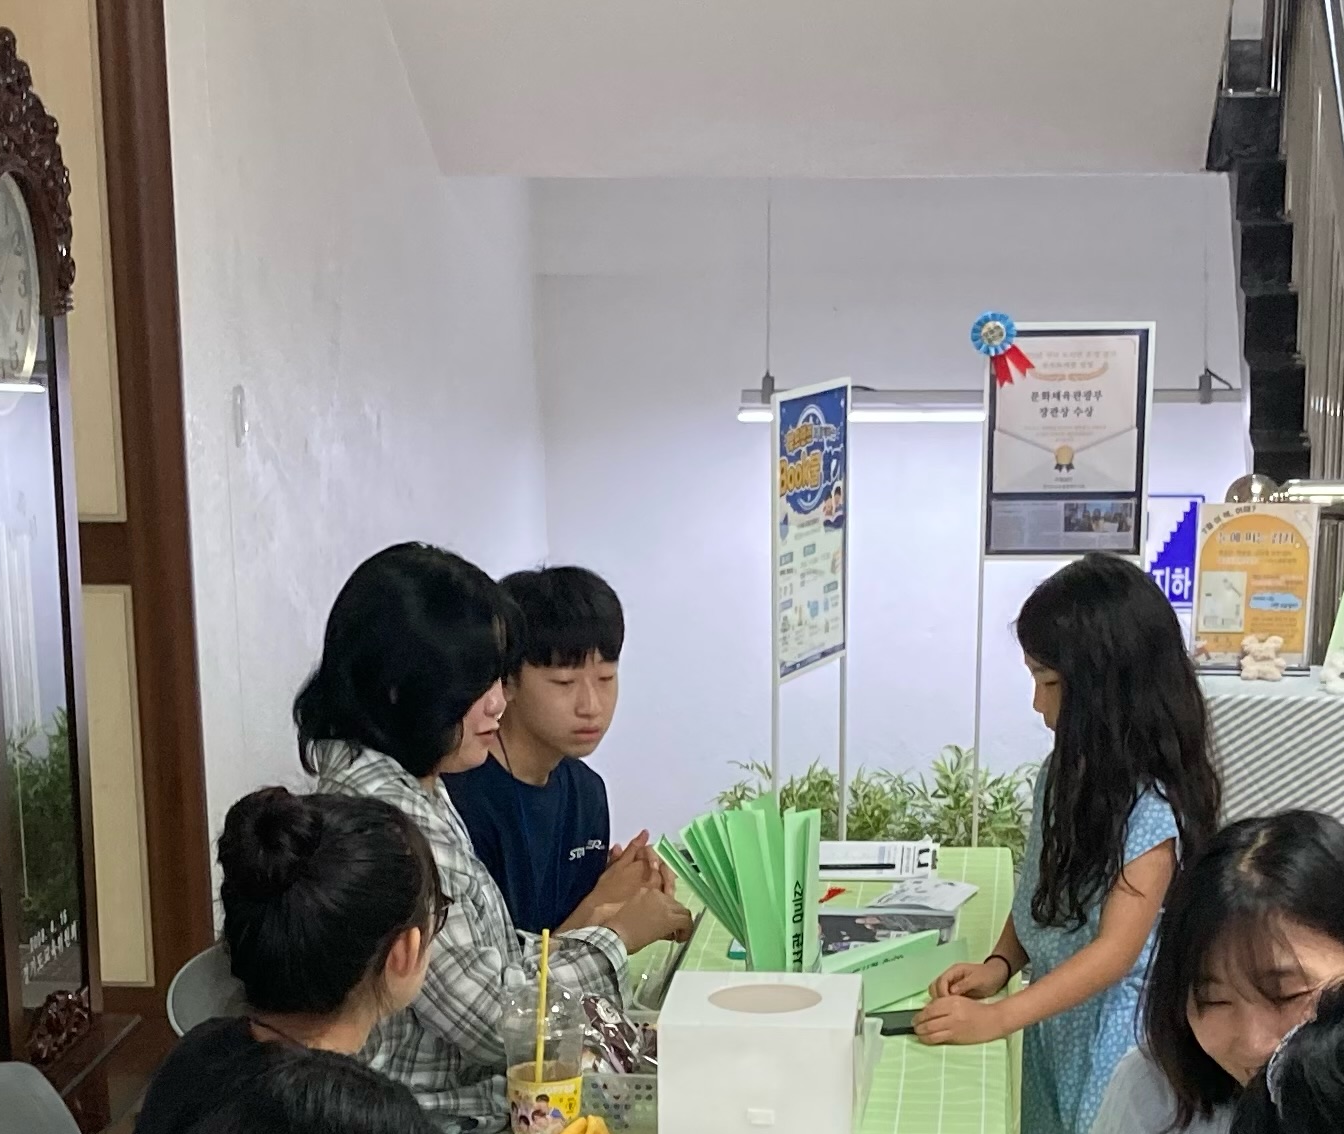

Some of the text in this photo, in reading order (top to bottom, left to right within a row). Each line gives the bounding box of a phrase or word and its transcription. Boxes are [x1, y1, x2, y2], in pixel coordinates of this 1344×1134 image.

[1031, 389, 1103, 402] 문화체육관광부
[1039, 406, 1094, 418] 장관상 수상
[1152, 566, 1190, 600] 지하
